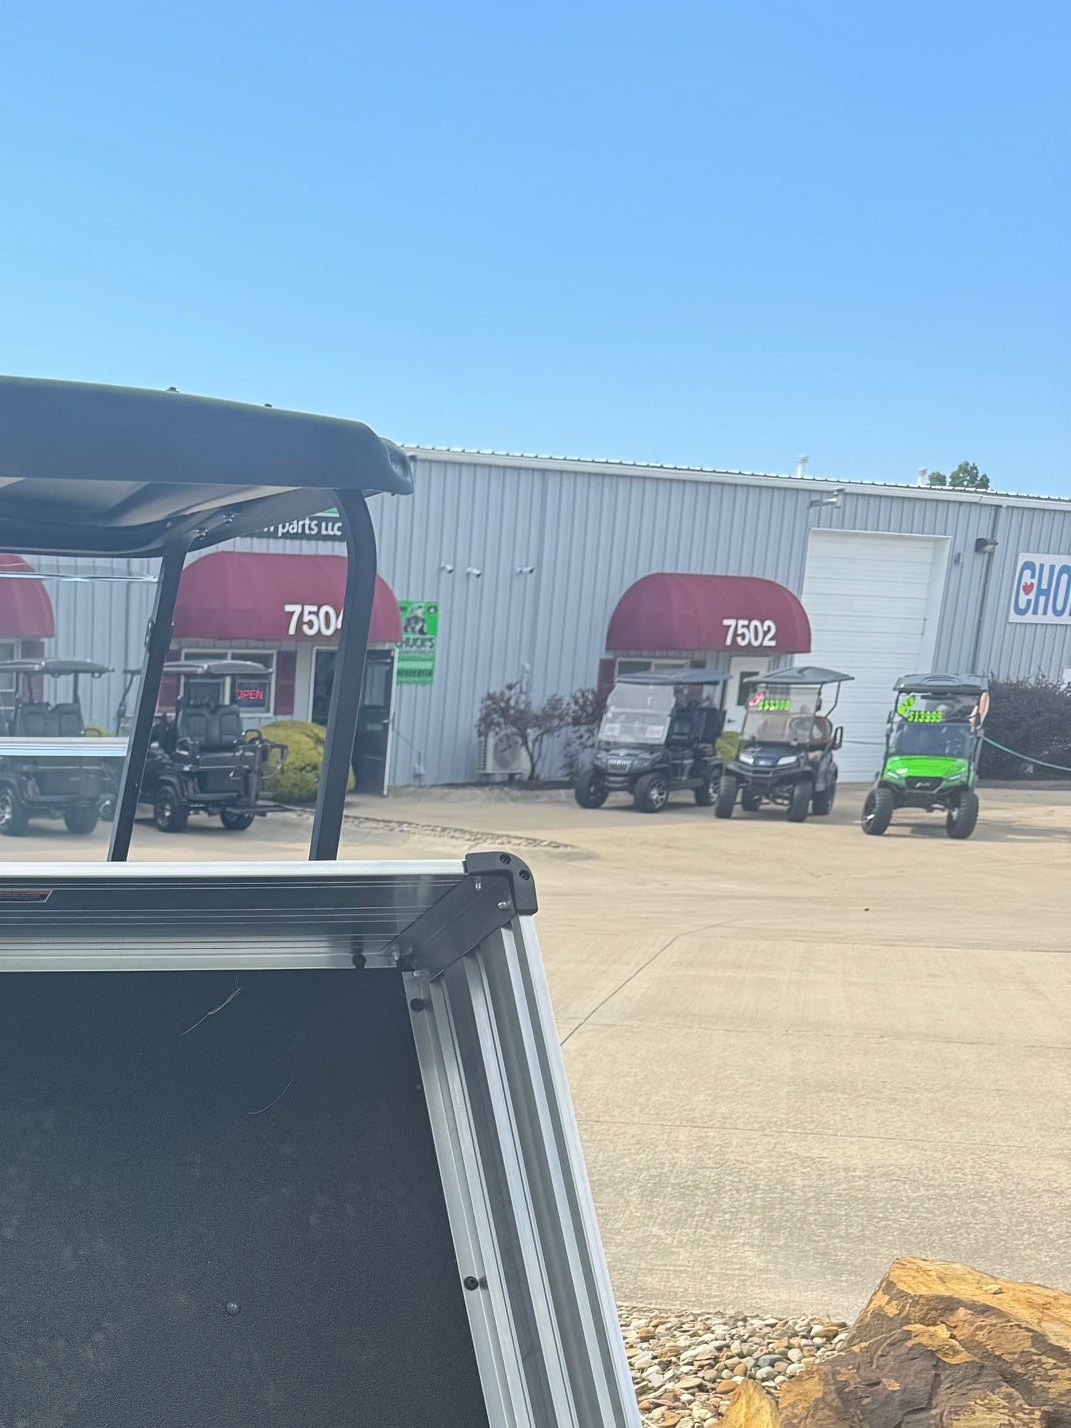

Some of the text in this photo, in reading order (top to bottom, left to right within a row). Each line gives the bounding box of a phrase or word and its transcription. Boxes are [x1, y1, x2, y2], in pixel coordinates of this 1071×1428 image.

[277, 516, 318, 537] parts
[321, 521, 343, 535] LLC
[1013, 560, 1071, 617] CHO
[722, 618, 776, 647] 7502
